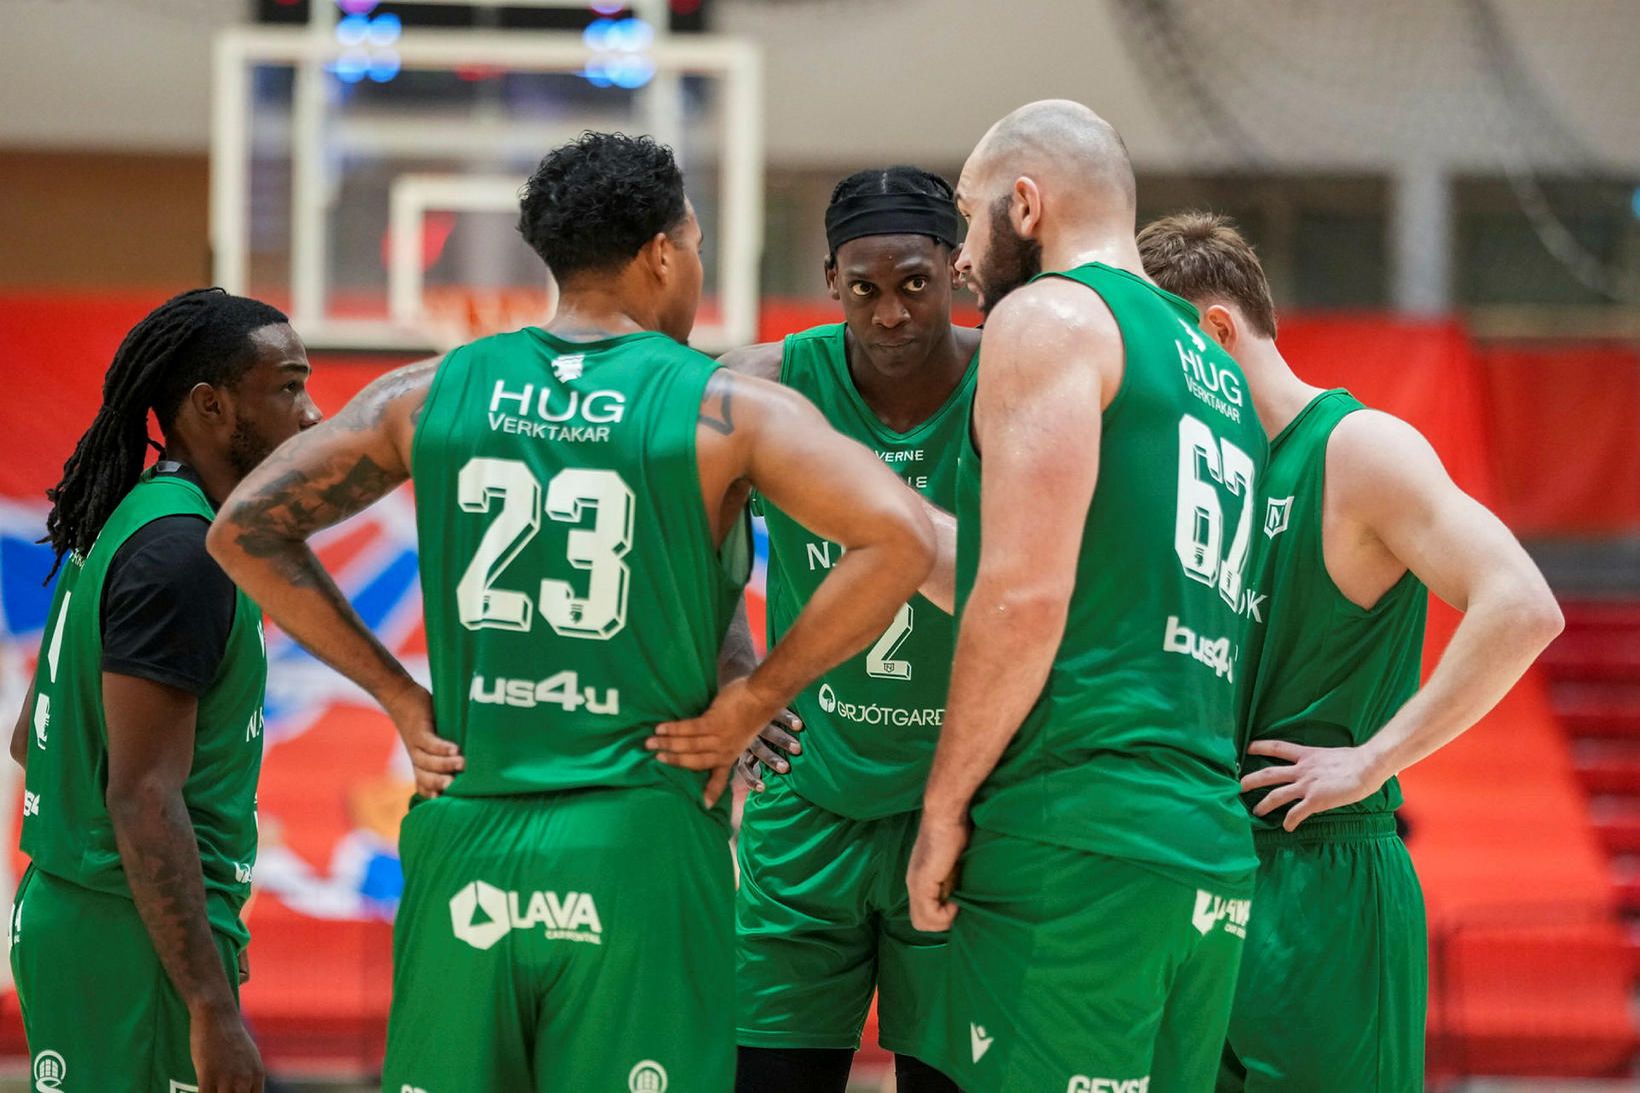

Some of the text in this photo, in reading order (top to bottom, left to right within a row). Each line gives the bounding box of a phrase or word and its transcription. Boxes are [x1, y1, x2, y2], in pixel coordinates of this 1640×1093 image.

[1175, 339, 1243, 407] HUG
[489, 379, 626, 423] HUG
[1184, 372, 1241, 424] VERKTAKAR
[488, 412, 611, 442] VERKTAKAR
[1175, 413, 1255, 614] 67
[456, 457, 635, 640] 23
[469, 670, 619, 715] us4u
[507, 891, 602, 934] LAVA
